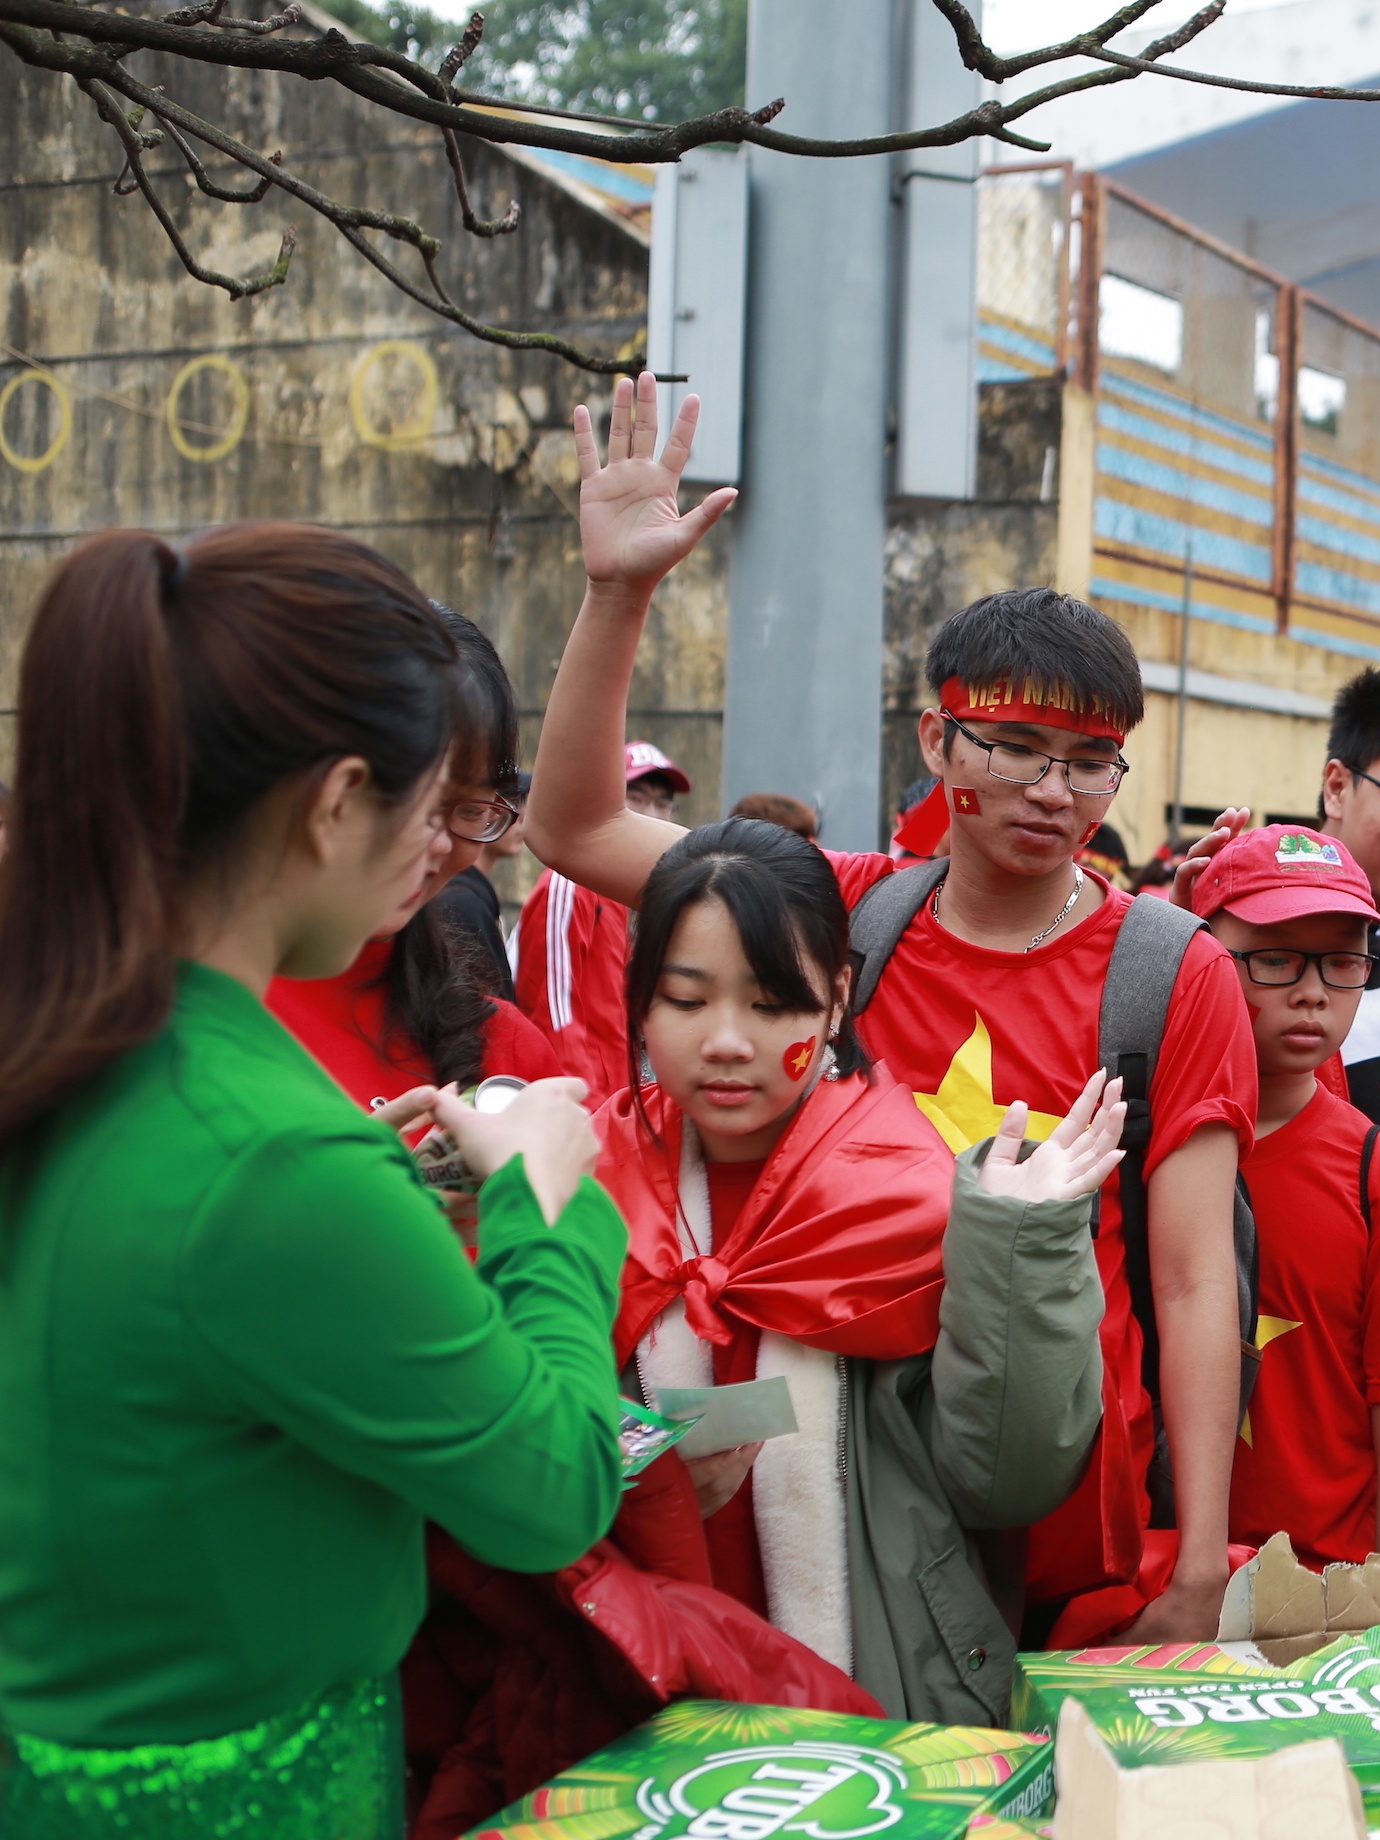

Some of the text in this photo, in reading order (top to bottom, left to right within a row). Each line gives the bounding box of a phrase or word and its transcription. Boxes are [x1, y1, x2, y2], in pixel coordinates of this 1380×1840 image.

[1127, 1679, 1305, 1699] OPEN FOR FUN
[667, 1762, 860, 1840] TUB
